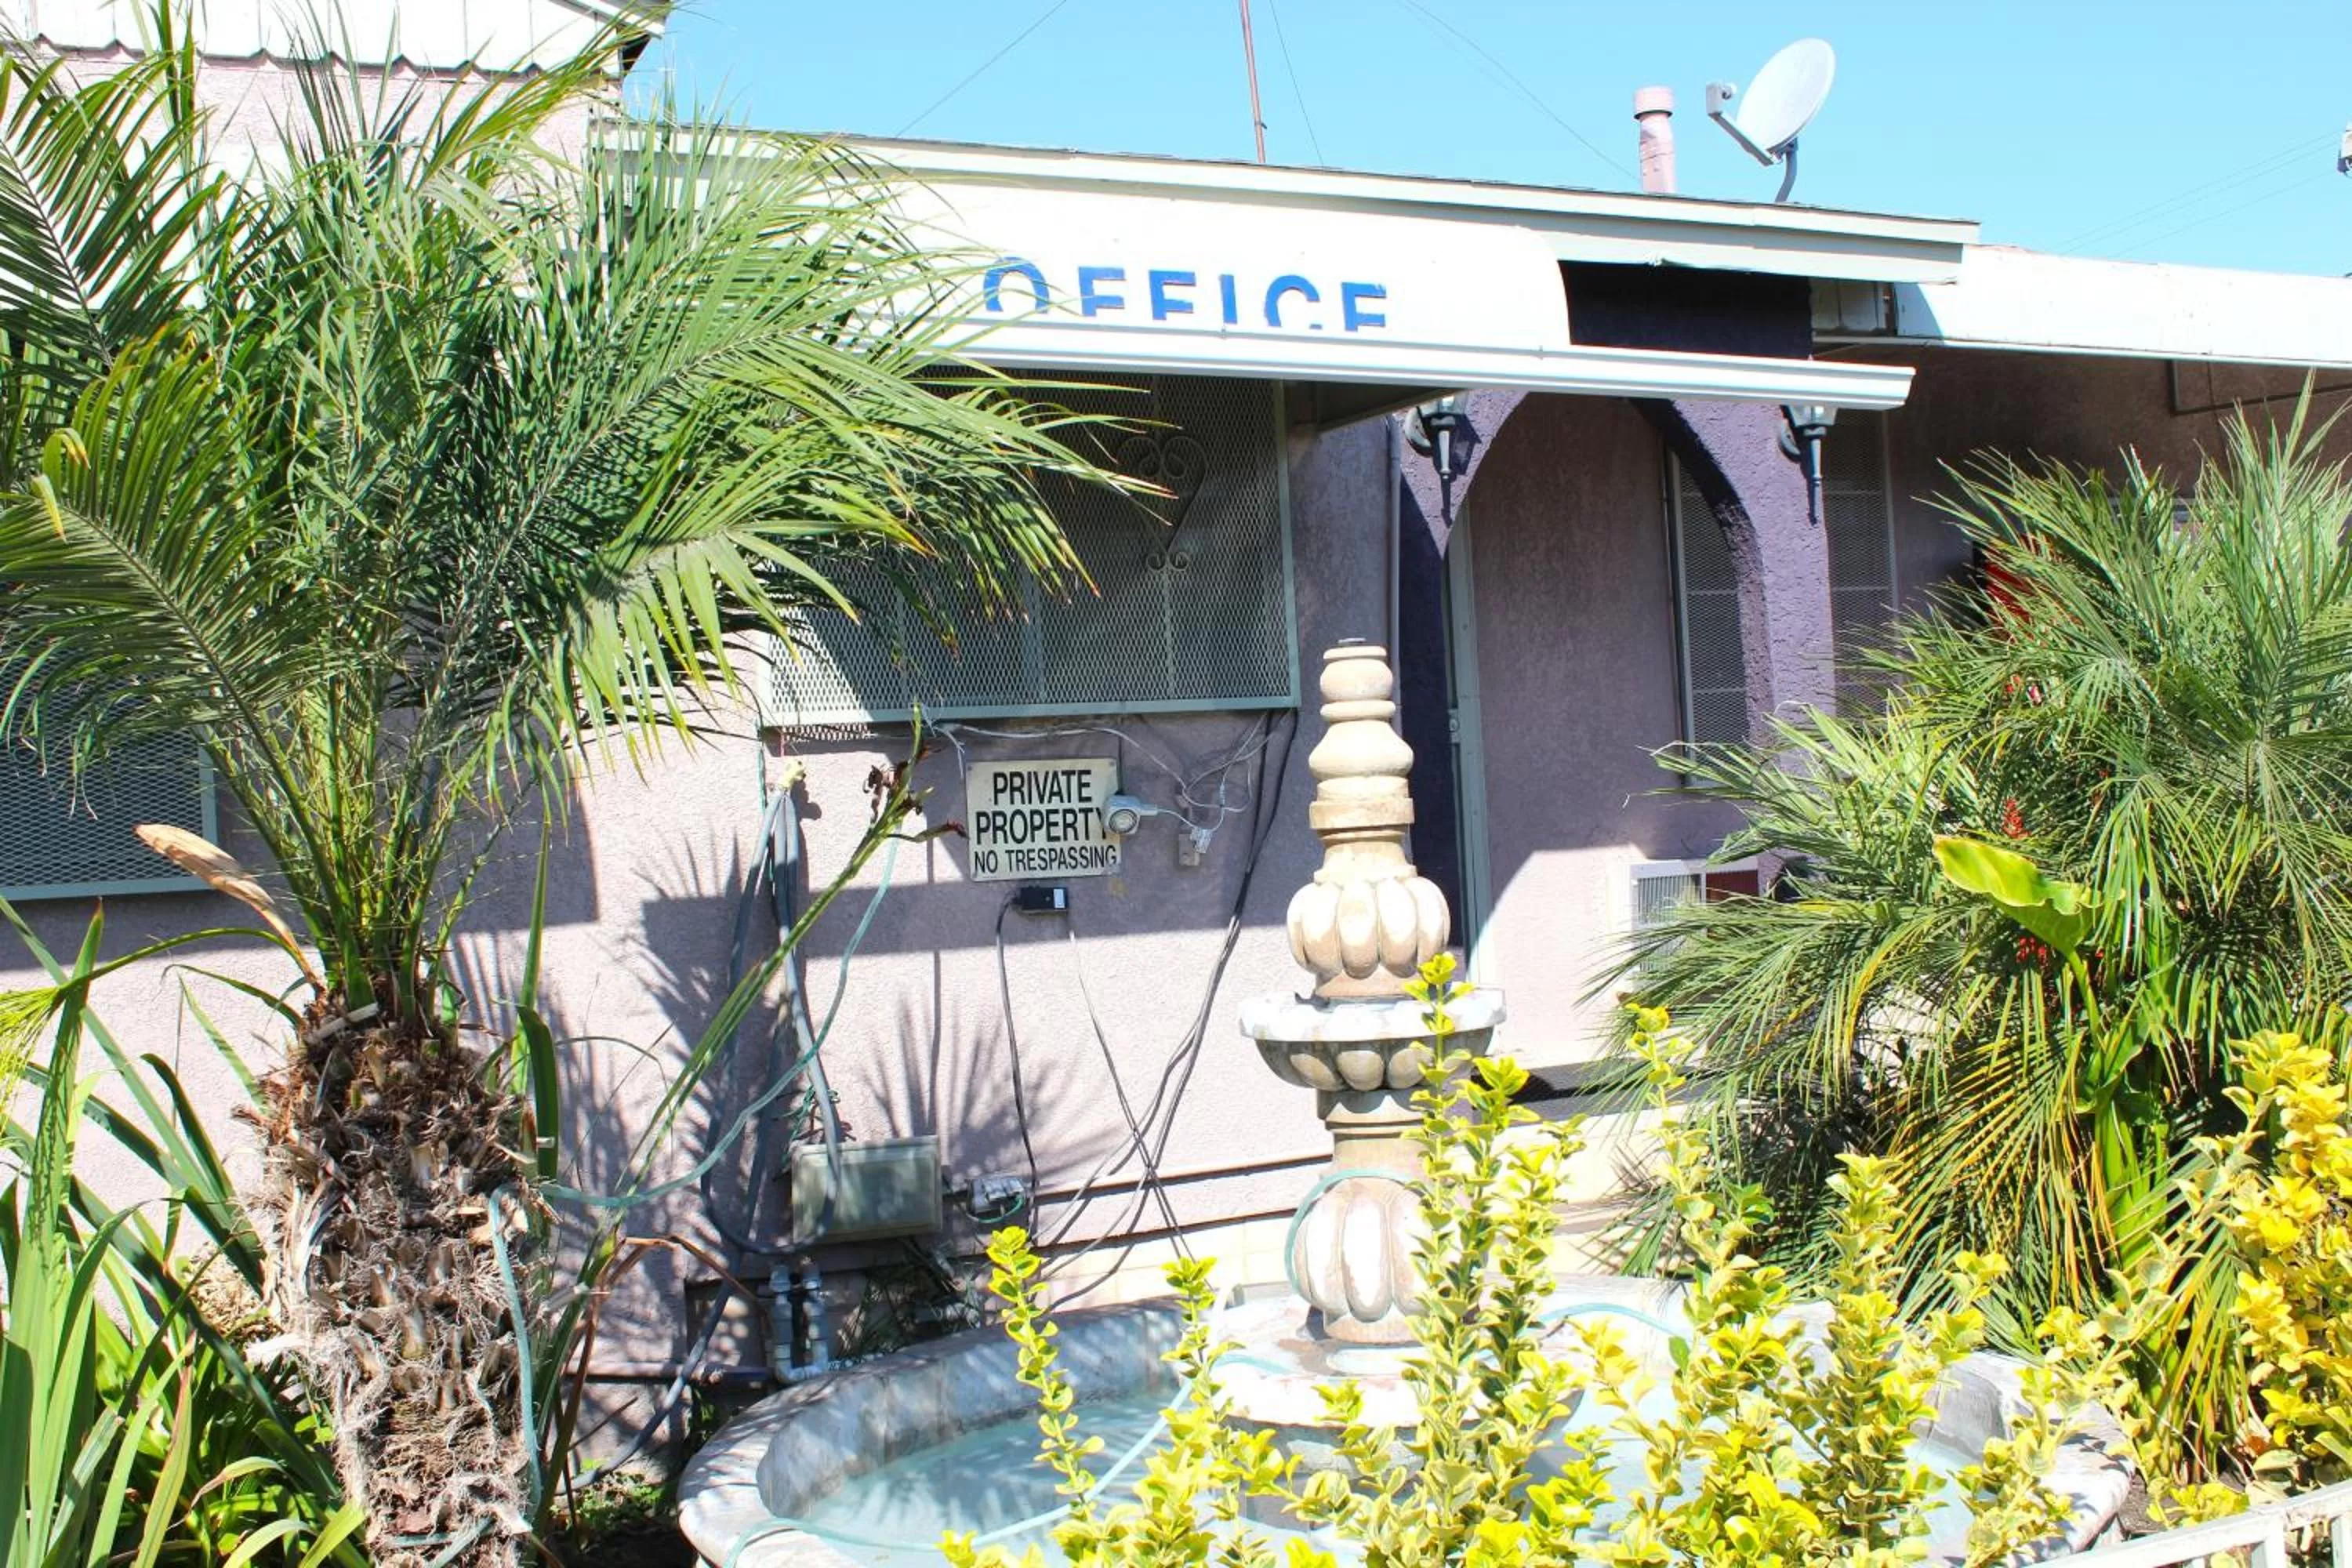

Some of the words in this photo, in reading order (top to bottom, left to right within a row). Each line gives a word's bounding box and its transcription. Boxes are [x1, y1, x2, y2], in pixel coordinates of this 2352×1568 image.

[982, 256, 1388, 332] OFFICE
[993, 769, 1092, 805] PRIVATE
[974, 849, 998, 873] NO
[1005, 844, 1117, 873] TRESPASSING
